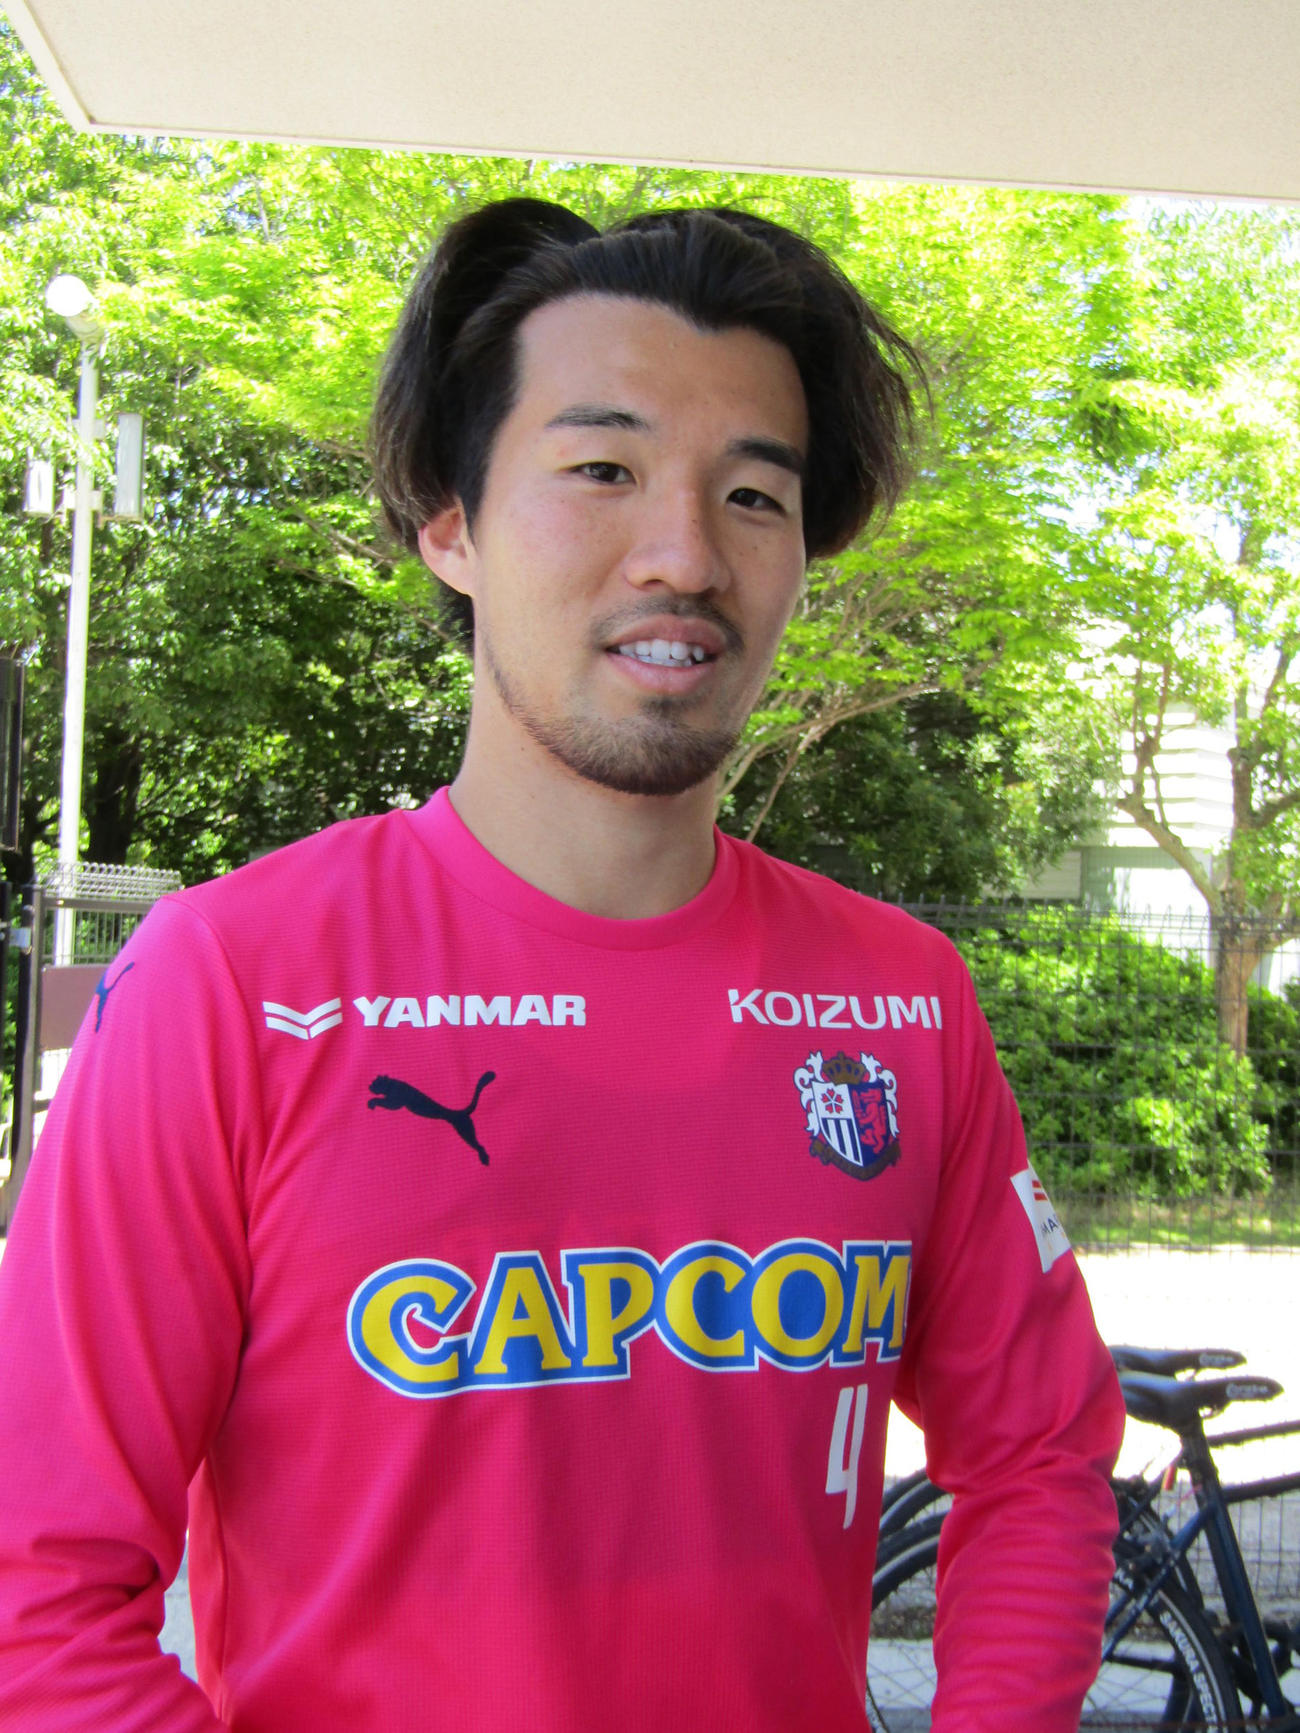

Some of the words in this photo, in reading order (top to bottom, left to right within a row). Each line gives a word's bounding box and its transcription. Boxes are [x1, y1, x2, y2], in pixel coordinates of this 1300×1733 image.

[352, 994, 587, 1028] YANMAR
[727, 988, 943, 1031] KOIZUMI
[346, 1237, 912, 1400] CAPCOM
[825, 1383, 869, 1530] 4
